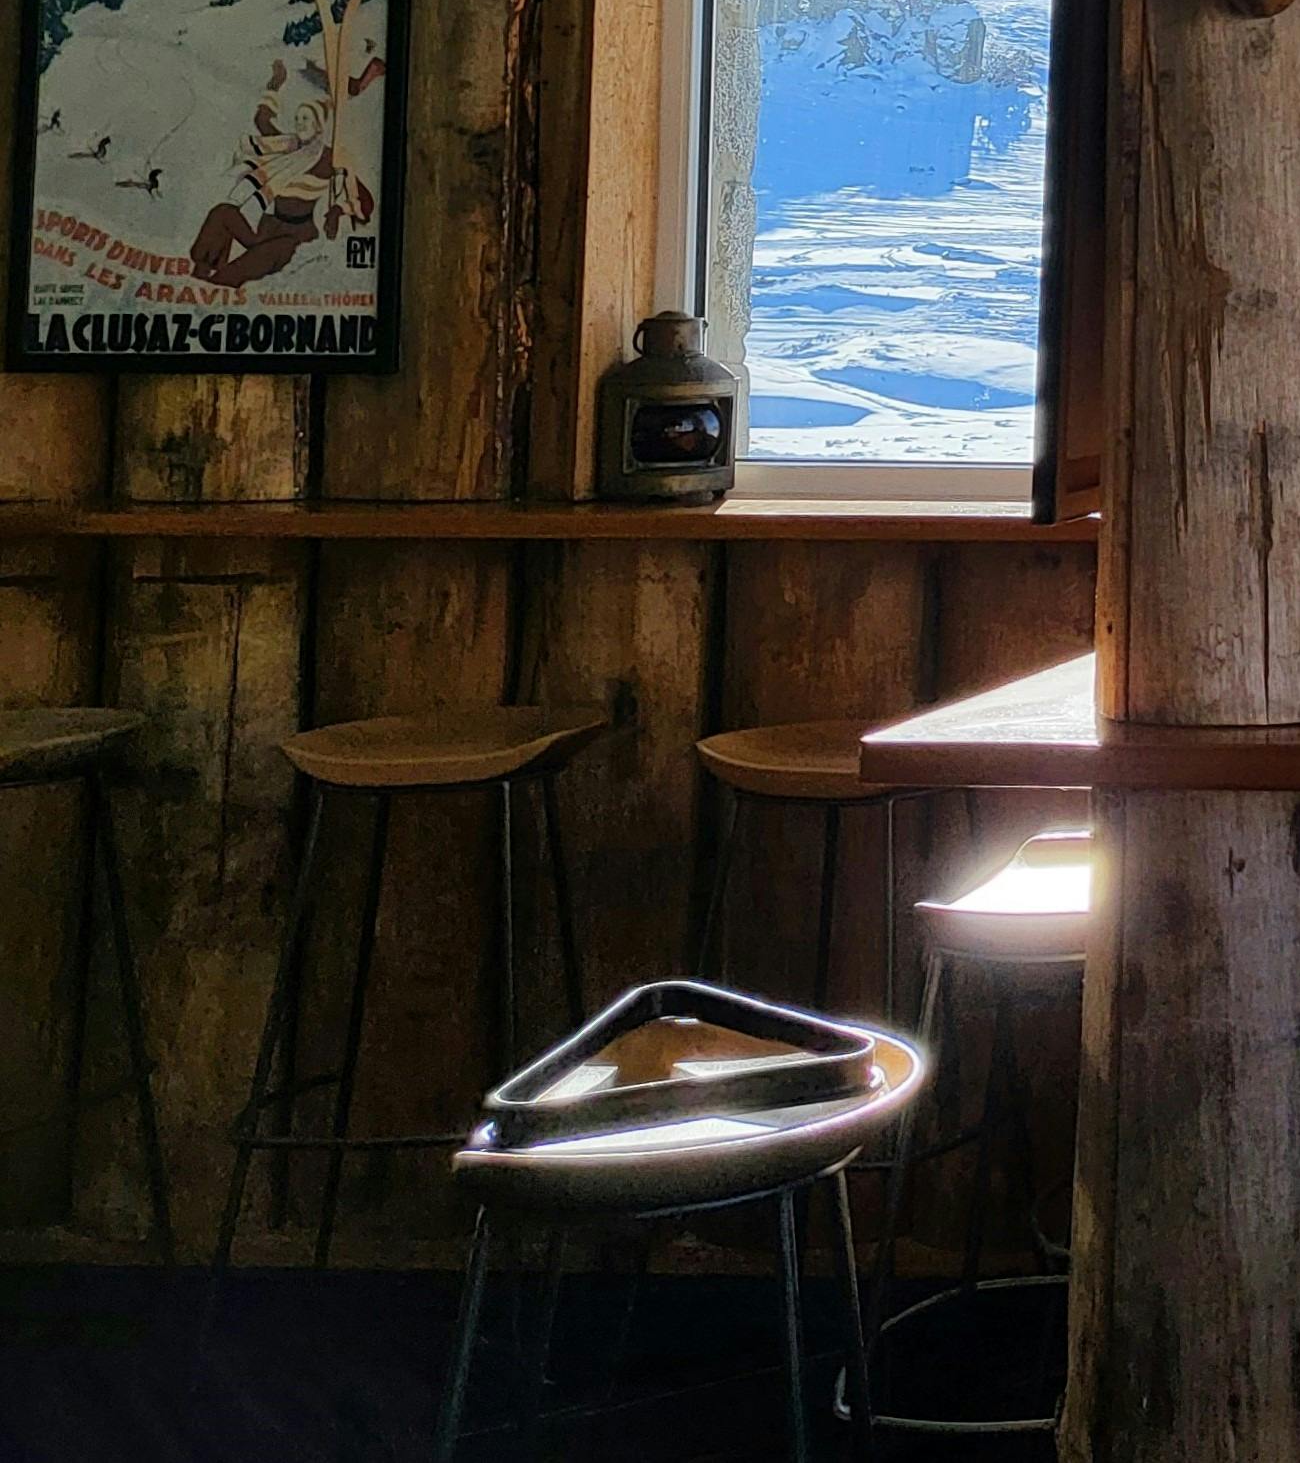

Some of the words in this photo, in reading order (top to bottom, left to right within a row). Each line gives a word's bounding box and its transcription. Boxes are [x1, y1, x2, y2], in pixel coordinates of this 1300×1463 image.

[36, 209, 111, 251] SPORTS
[33, 237, 77, 267] DANS
[85, 262, 126, 290] LES
[135, 281, 247, 306] ARAVIS
